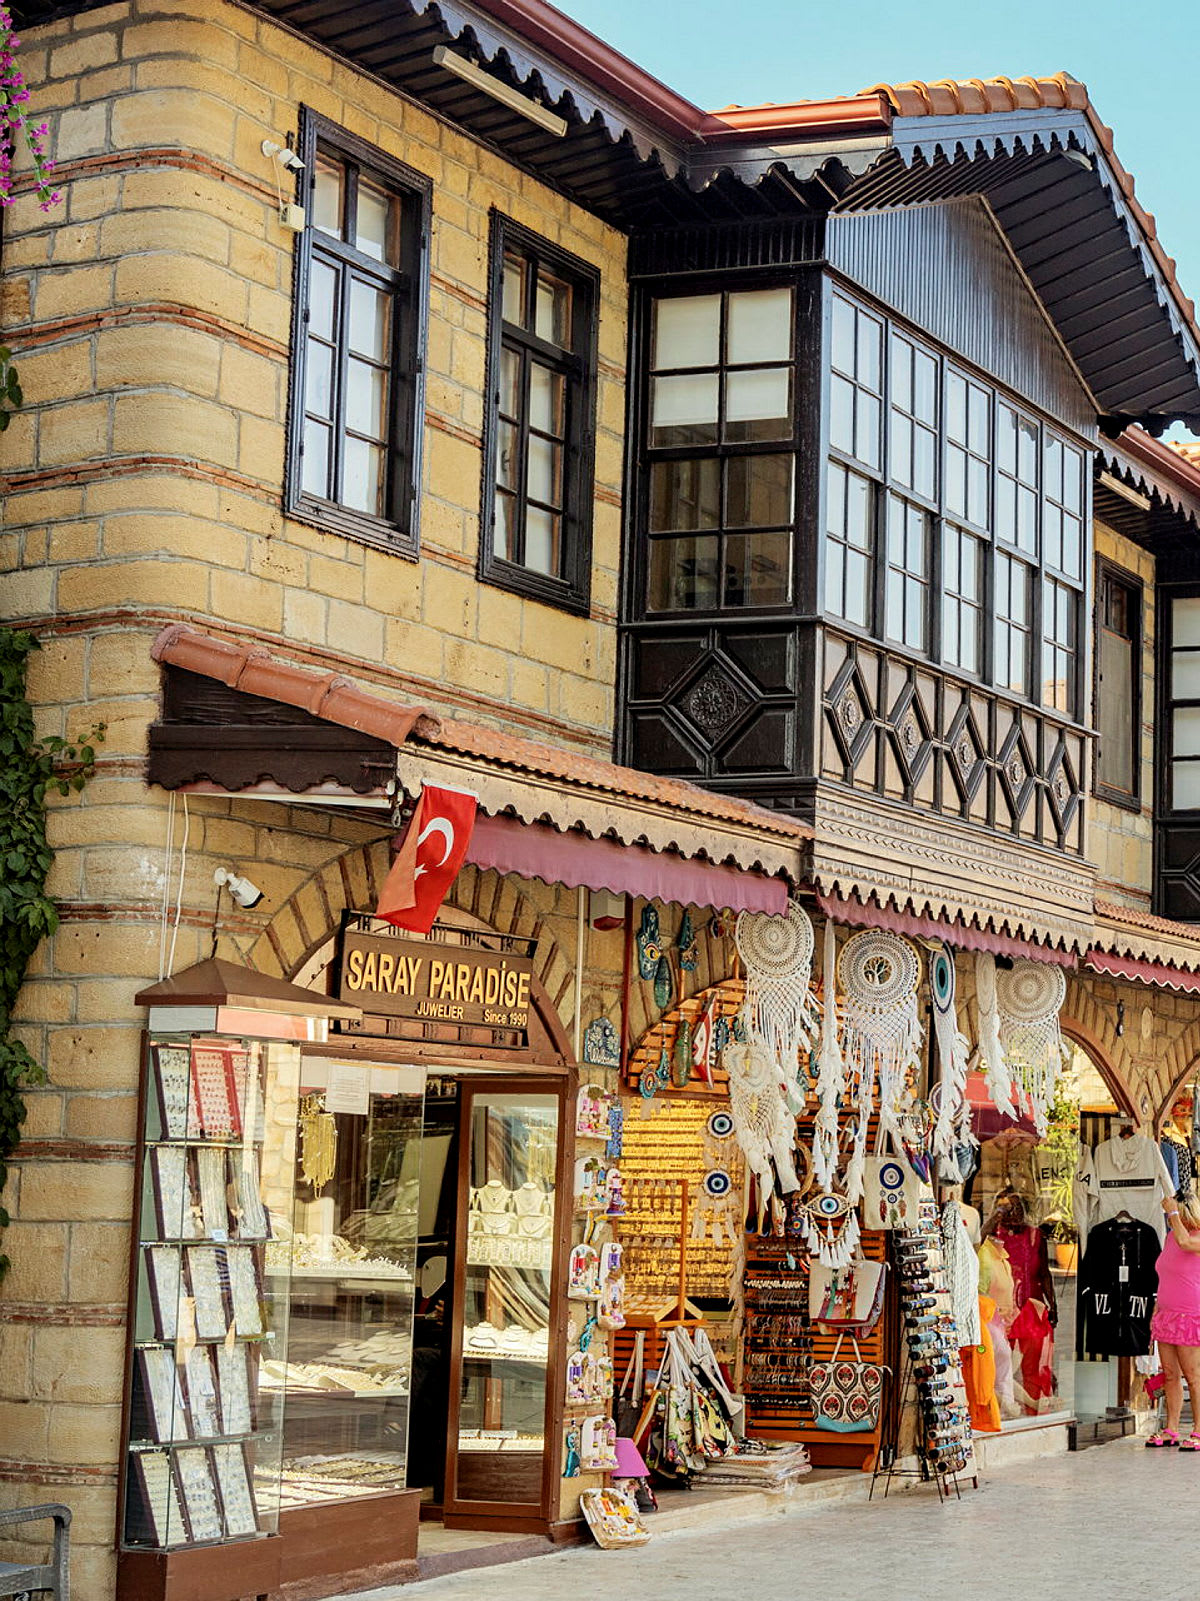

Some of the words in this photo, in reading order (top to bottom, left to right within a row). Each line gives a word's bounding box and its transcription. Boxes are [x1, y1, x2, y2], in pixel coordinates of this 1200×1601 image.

[347, 949, 423, 996] SARAY
[416, 1001, 464, 1020] JUWELIER
[484, 1008, 507, 1025] Since
[509, 1012, 528, 1027] 1990
[1094, 1293, 1112, 1315] VL
[1129, 1295, 1148, 1319] TN
